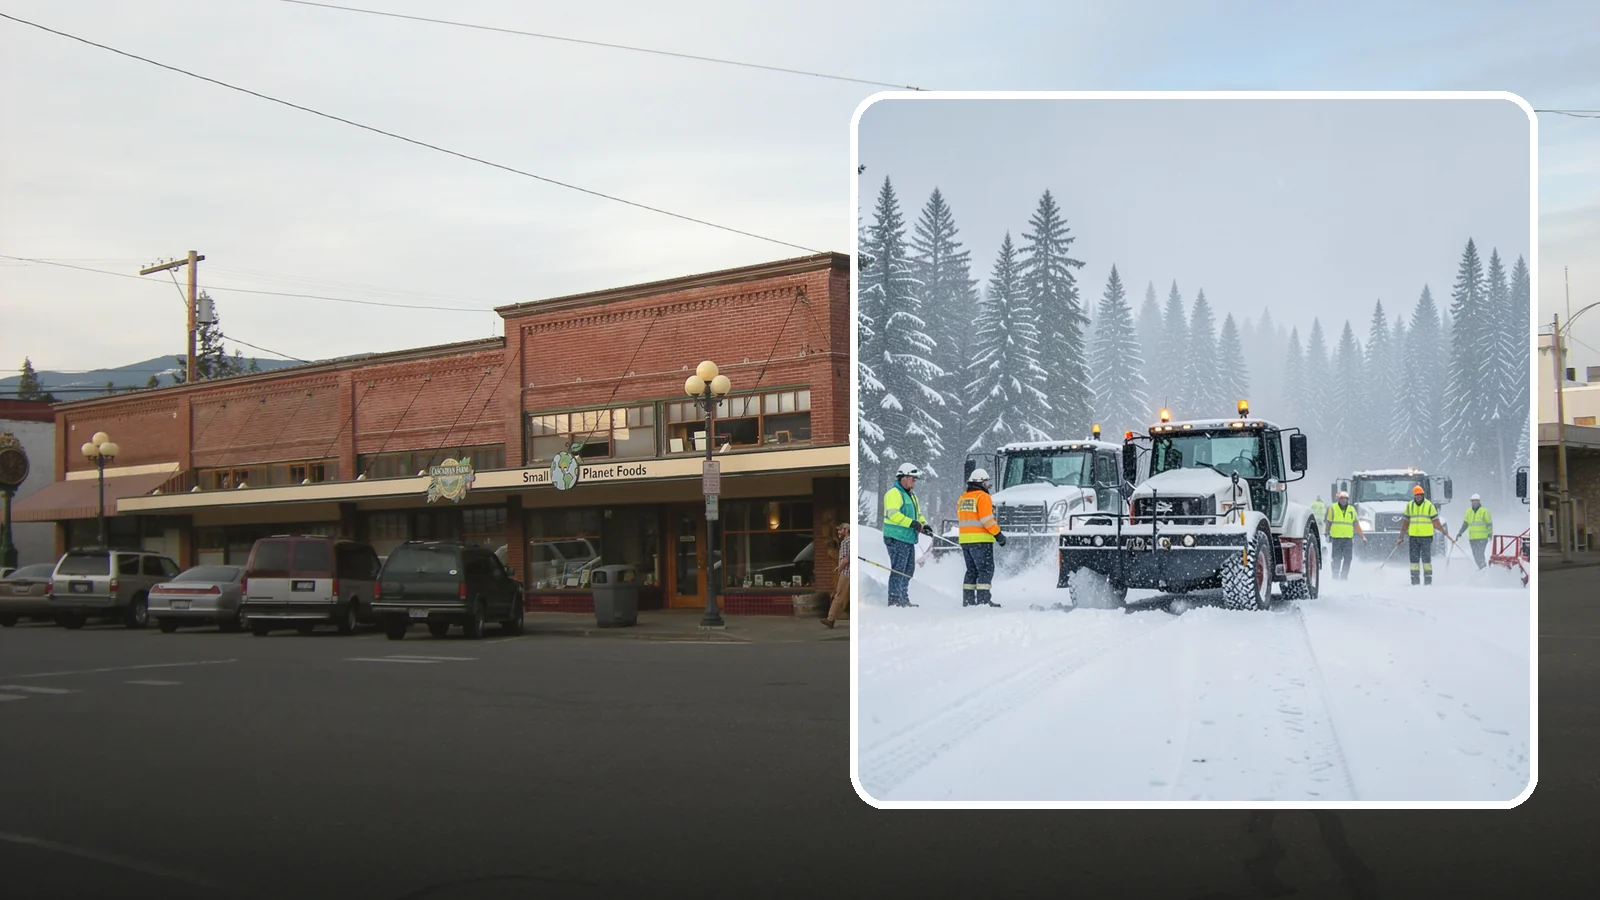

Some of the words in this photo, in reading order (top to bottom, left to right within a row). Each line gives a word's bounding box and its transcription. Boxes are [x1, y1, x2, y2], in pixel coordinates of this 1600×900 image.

[522, 471, 549, 483] Small
[582, 467, 614, 479] Planet
[616, 464, 647, 477] Foods
